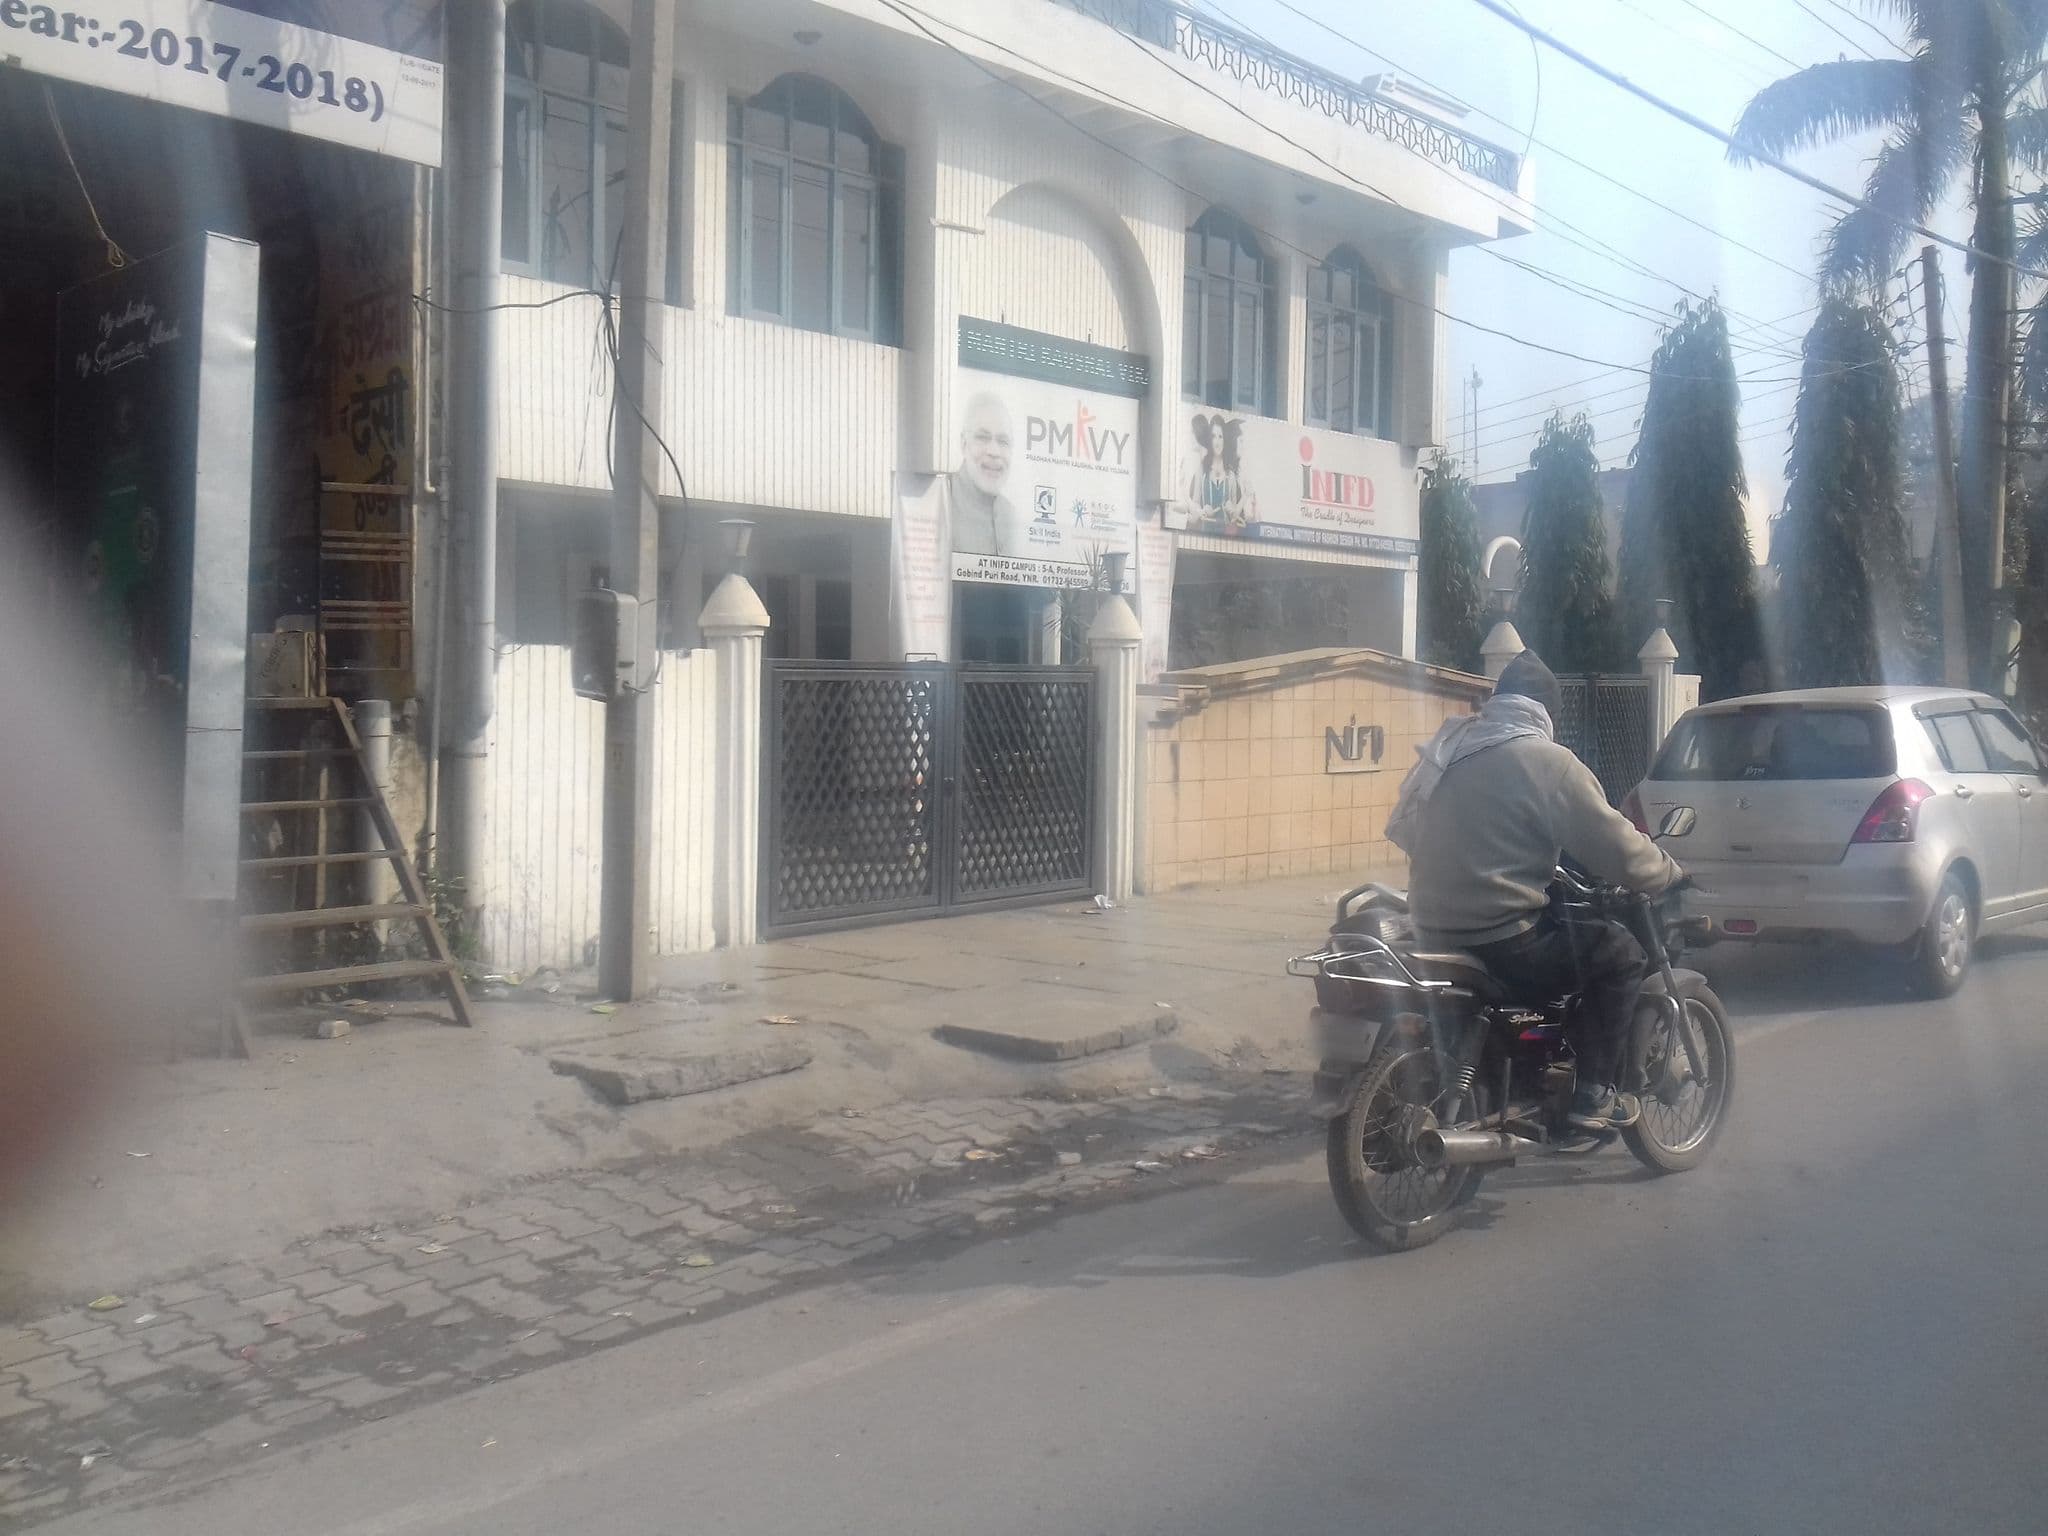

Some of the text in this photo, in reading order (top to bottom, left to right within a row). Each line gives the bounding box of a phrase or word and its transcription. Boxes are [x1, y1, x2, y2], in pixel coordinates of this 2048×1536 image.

[1026, 399, 1130, 465] PMKVY
[956, 568, 983, 580] Gobind
[984, 570, 1000, 580] Puri
[1000, 572, 1021, 583] Road,
[978, 558, 988, 568] AT
[989, 559, 1010, 571] INIFD
[1011, 561, 1036, 573] CAMPUS
[1056, 566, 1089, 577] Professor
